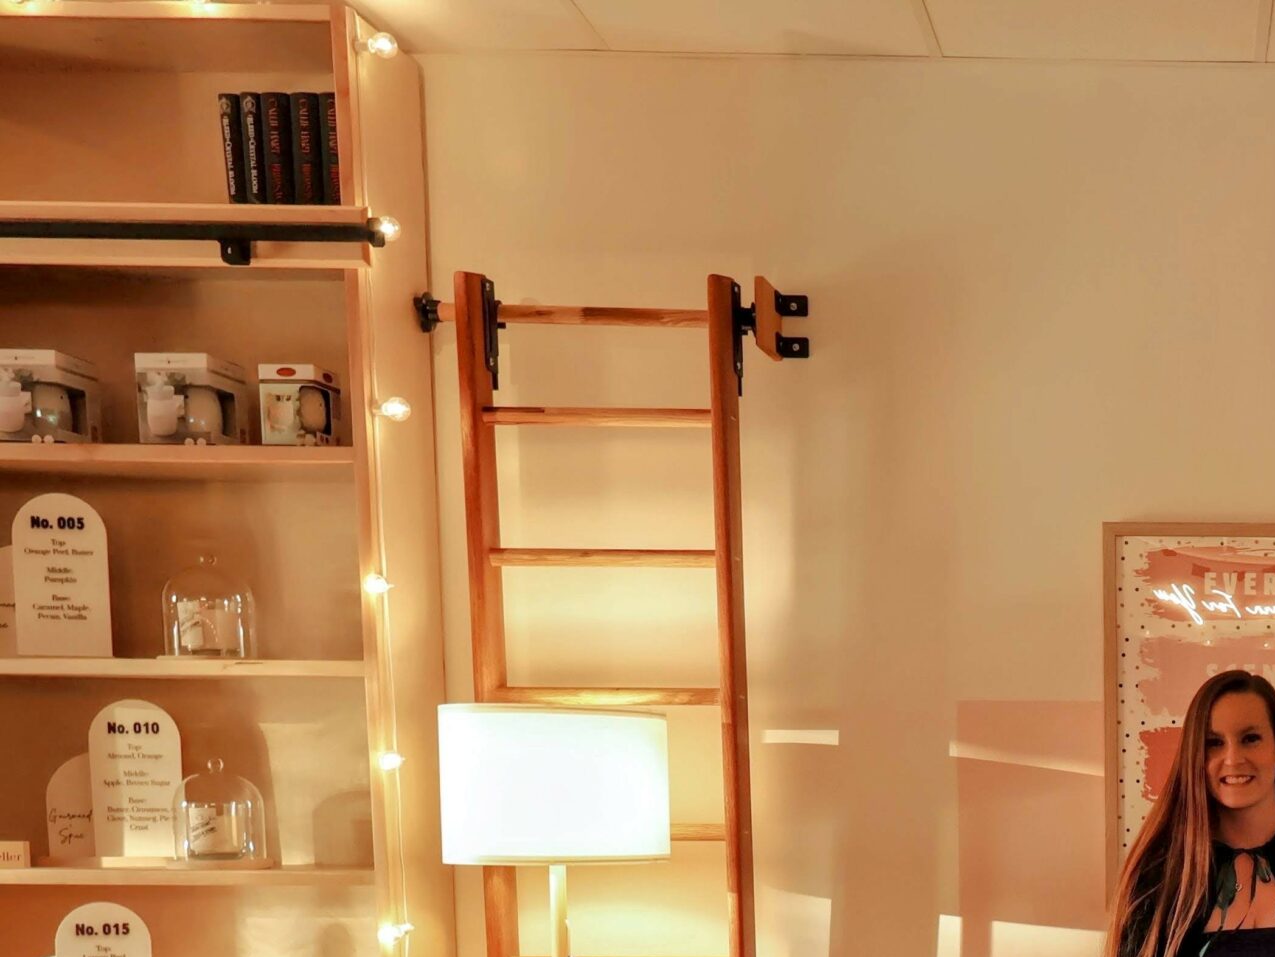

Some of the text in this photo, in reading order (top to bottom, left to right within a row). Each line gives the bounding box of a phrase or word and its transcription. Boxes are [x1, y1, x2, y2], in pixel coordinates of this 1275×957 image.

[30, 515, 85, 530] No. 005
[107, 721, 160, 735] No. 010
[75, 922, 130, 936] No. 015
